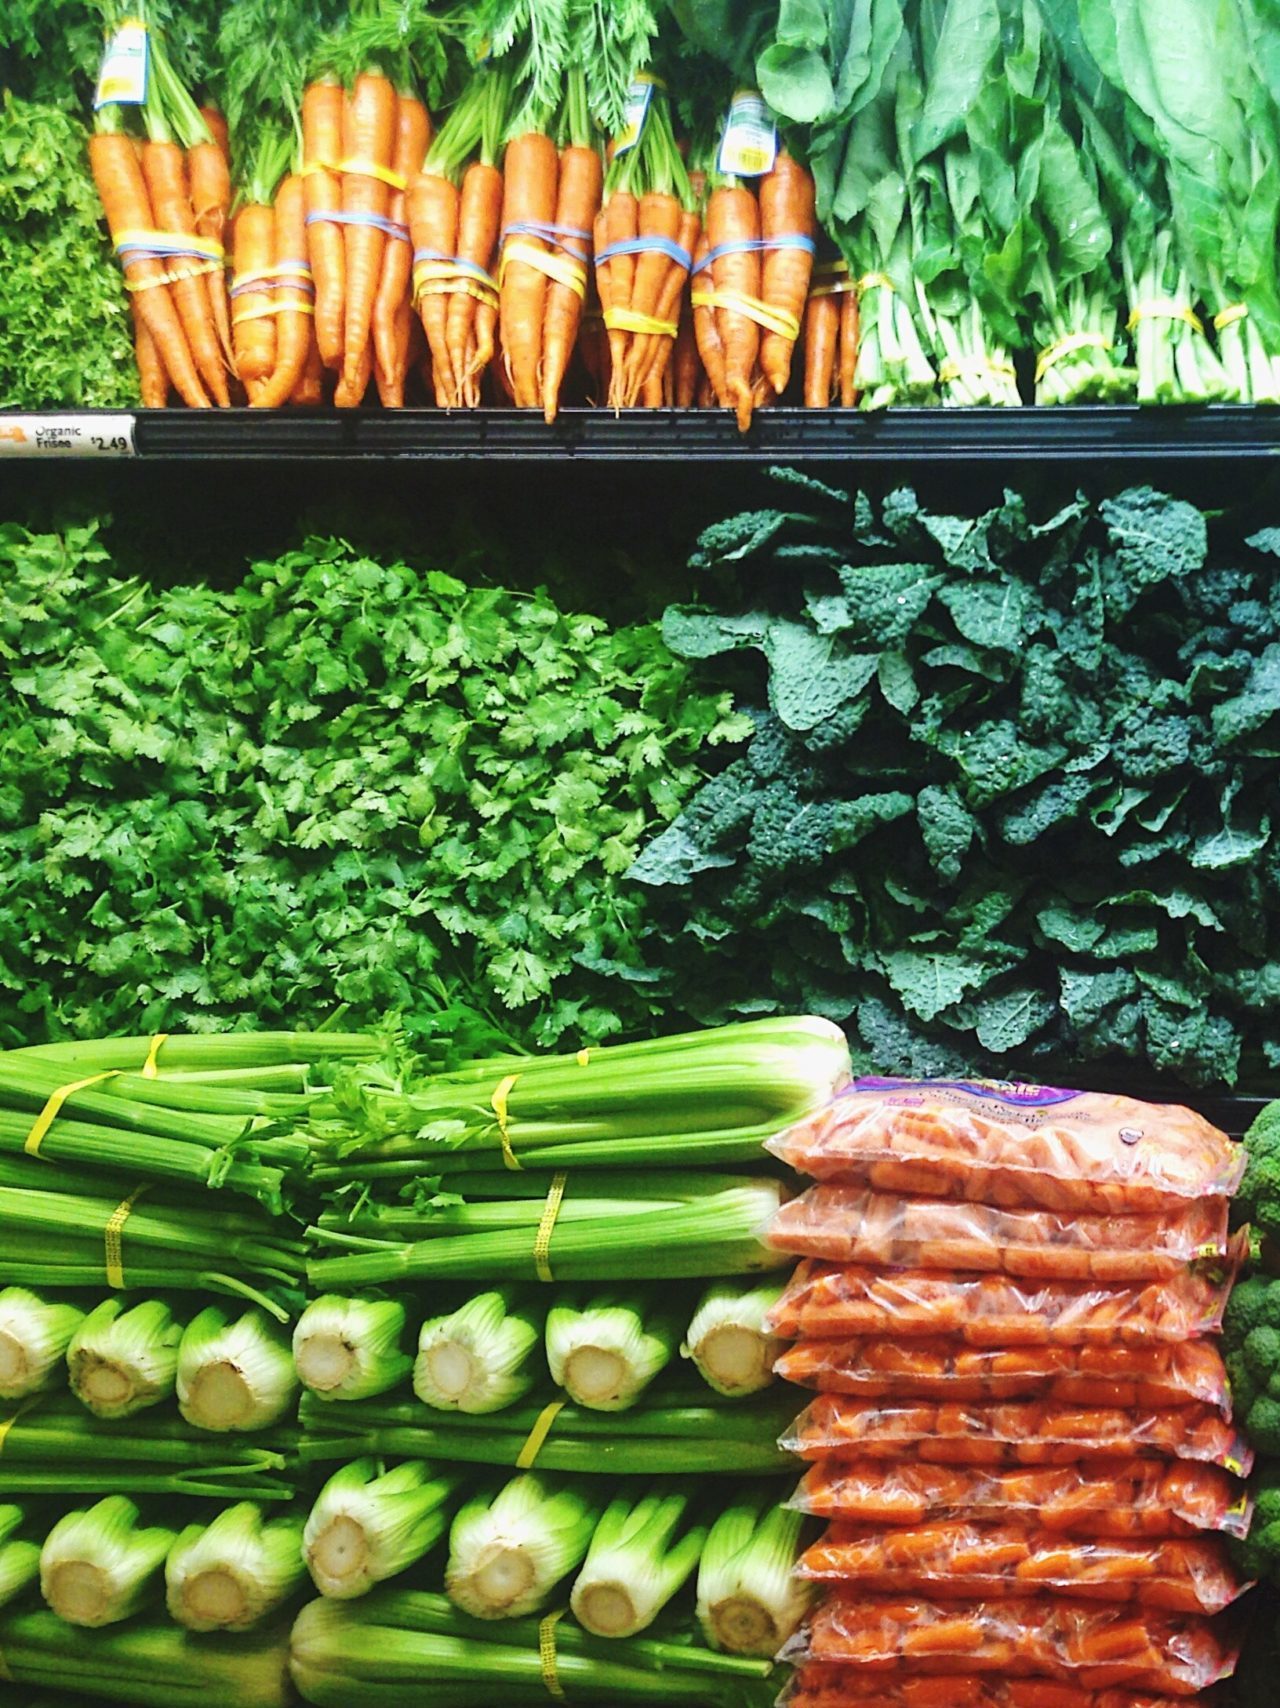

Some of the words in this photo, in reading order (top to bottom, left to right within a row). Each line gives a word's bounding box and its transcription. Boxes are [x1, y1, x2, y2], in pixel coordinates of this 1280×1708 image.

[35, 426, 82, 439] Organic
[36, 438, 72, 448] Frisee
[91, 437, 127, 450] $2.49
